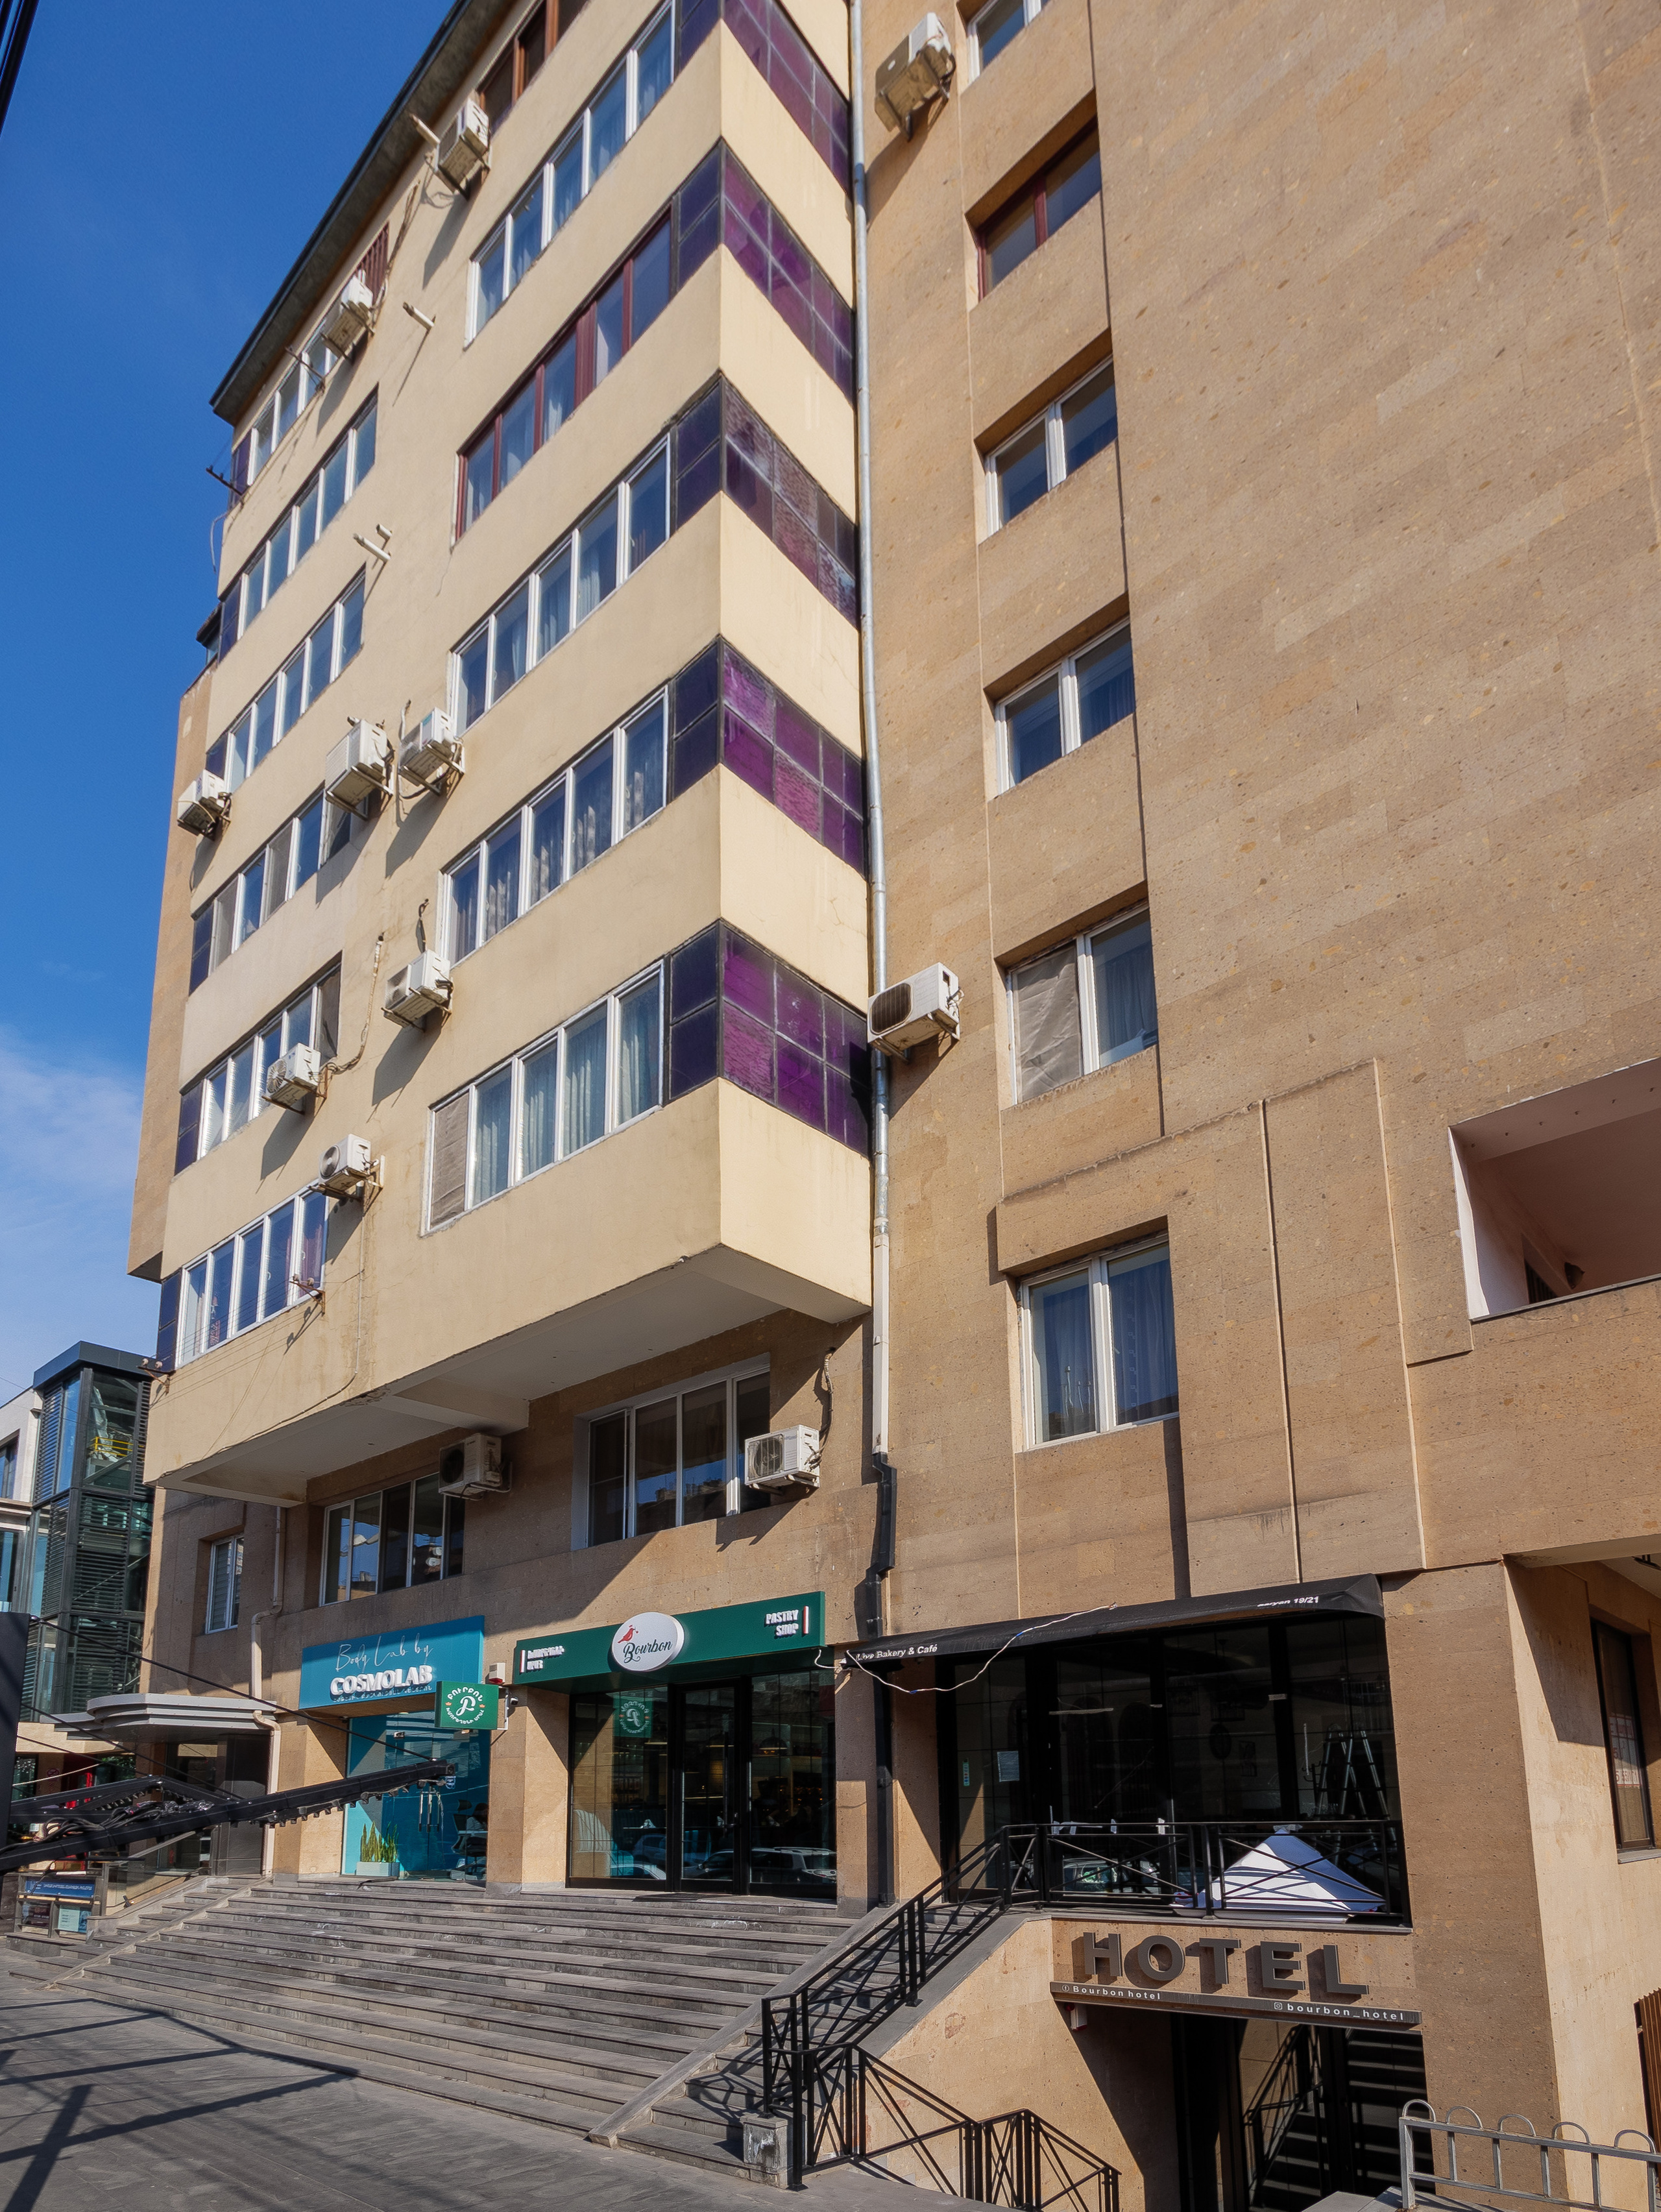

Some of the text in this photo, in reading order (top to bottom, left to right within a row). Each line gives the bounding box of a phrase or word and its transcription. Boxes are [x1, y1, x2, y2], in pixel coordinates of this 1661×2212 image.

[766, 1609, 799, 1624] PASTRY
[776, 1623, 799, 1636] SHOP
[335, 1633, 434, 1673] Body Lab by
[623, 1639, 673, 1664] Bourbon
[876, 1649, 906, 1658] Bakery
[908, 1647, 915, 1655] &
[917, 1644, 938, 1654] Café
[330, 1664, 433, 1695] COSMOLAB
[1083, 1932, 1370, 1995] HOTEL
[1073, 1986, 1160, 2000] Bourbon hotel
[1287, 2003, 1403, 2021] bourbon_hotel
